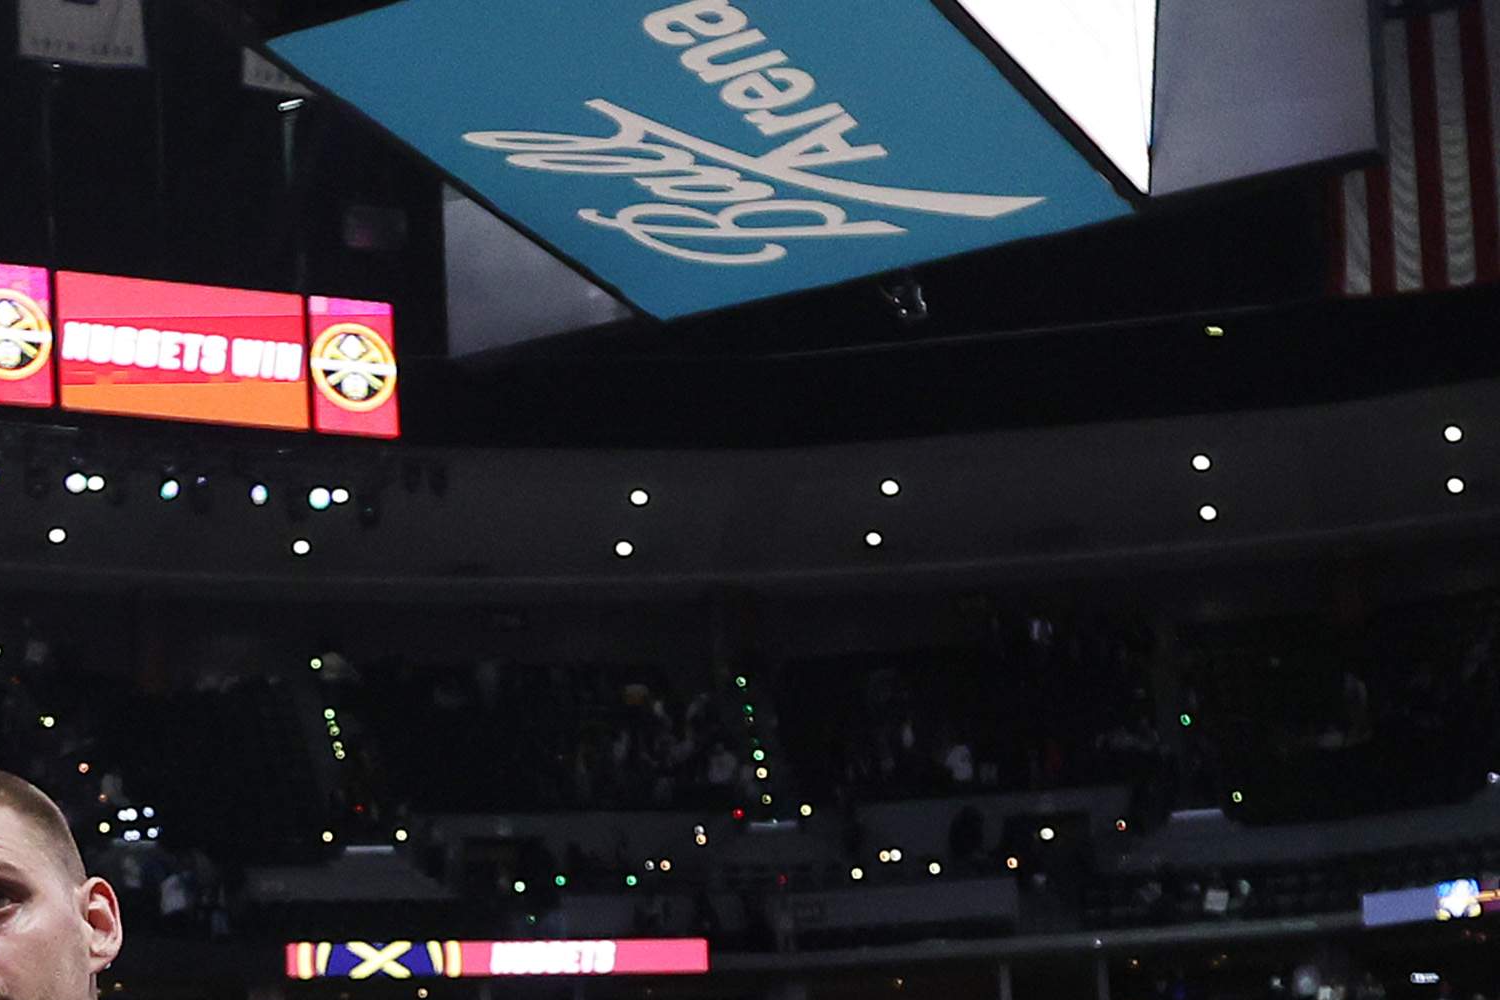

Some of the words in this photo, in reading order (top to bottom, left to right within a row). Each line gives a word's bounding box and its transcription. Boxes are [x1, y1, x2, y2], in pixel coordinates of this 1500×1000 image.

[642, 0, 888, 170] Arena
[461, 97, 1047, 265] Ball
[62, 321, 228, 374] NUGGETS
[231, 337, 303, 381] WIN
